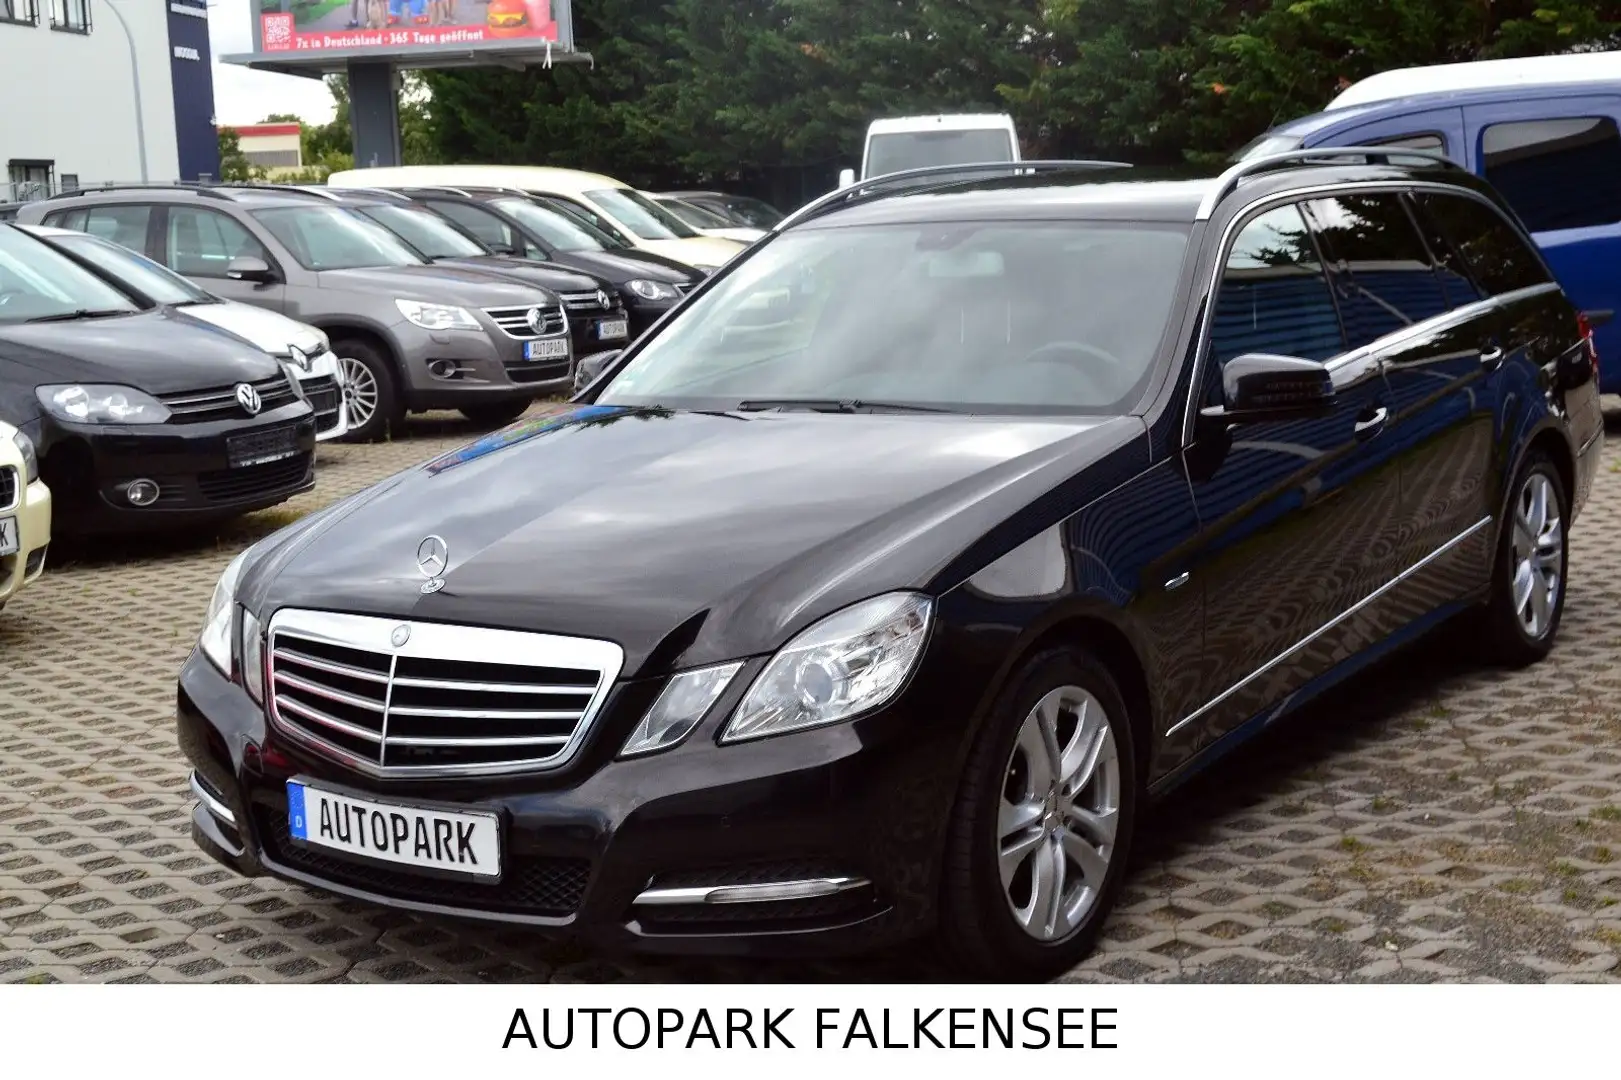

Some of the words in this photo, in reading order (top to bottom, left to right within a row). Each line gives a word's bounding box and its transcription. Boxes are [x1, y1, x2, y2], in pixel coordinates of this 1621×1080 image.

[296, 37, 309, 49] 7x
[311, 36, 321, 48] in
[324, 33, 382, 48] Deutschland
[390, 31, 409, 45] 365
[412, 31, 435, 44] Tage
[440, 29, 483, 44] geöffnet
[532, 340, 564, 355] AUTOPARK
[320, 797, 478, 865] AUTOPARK
